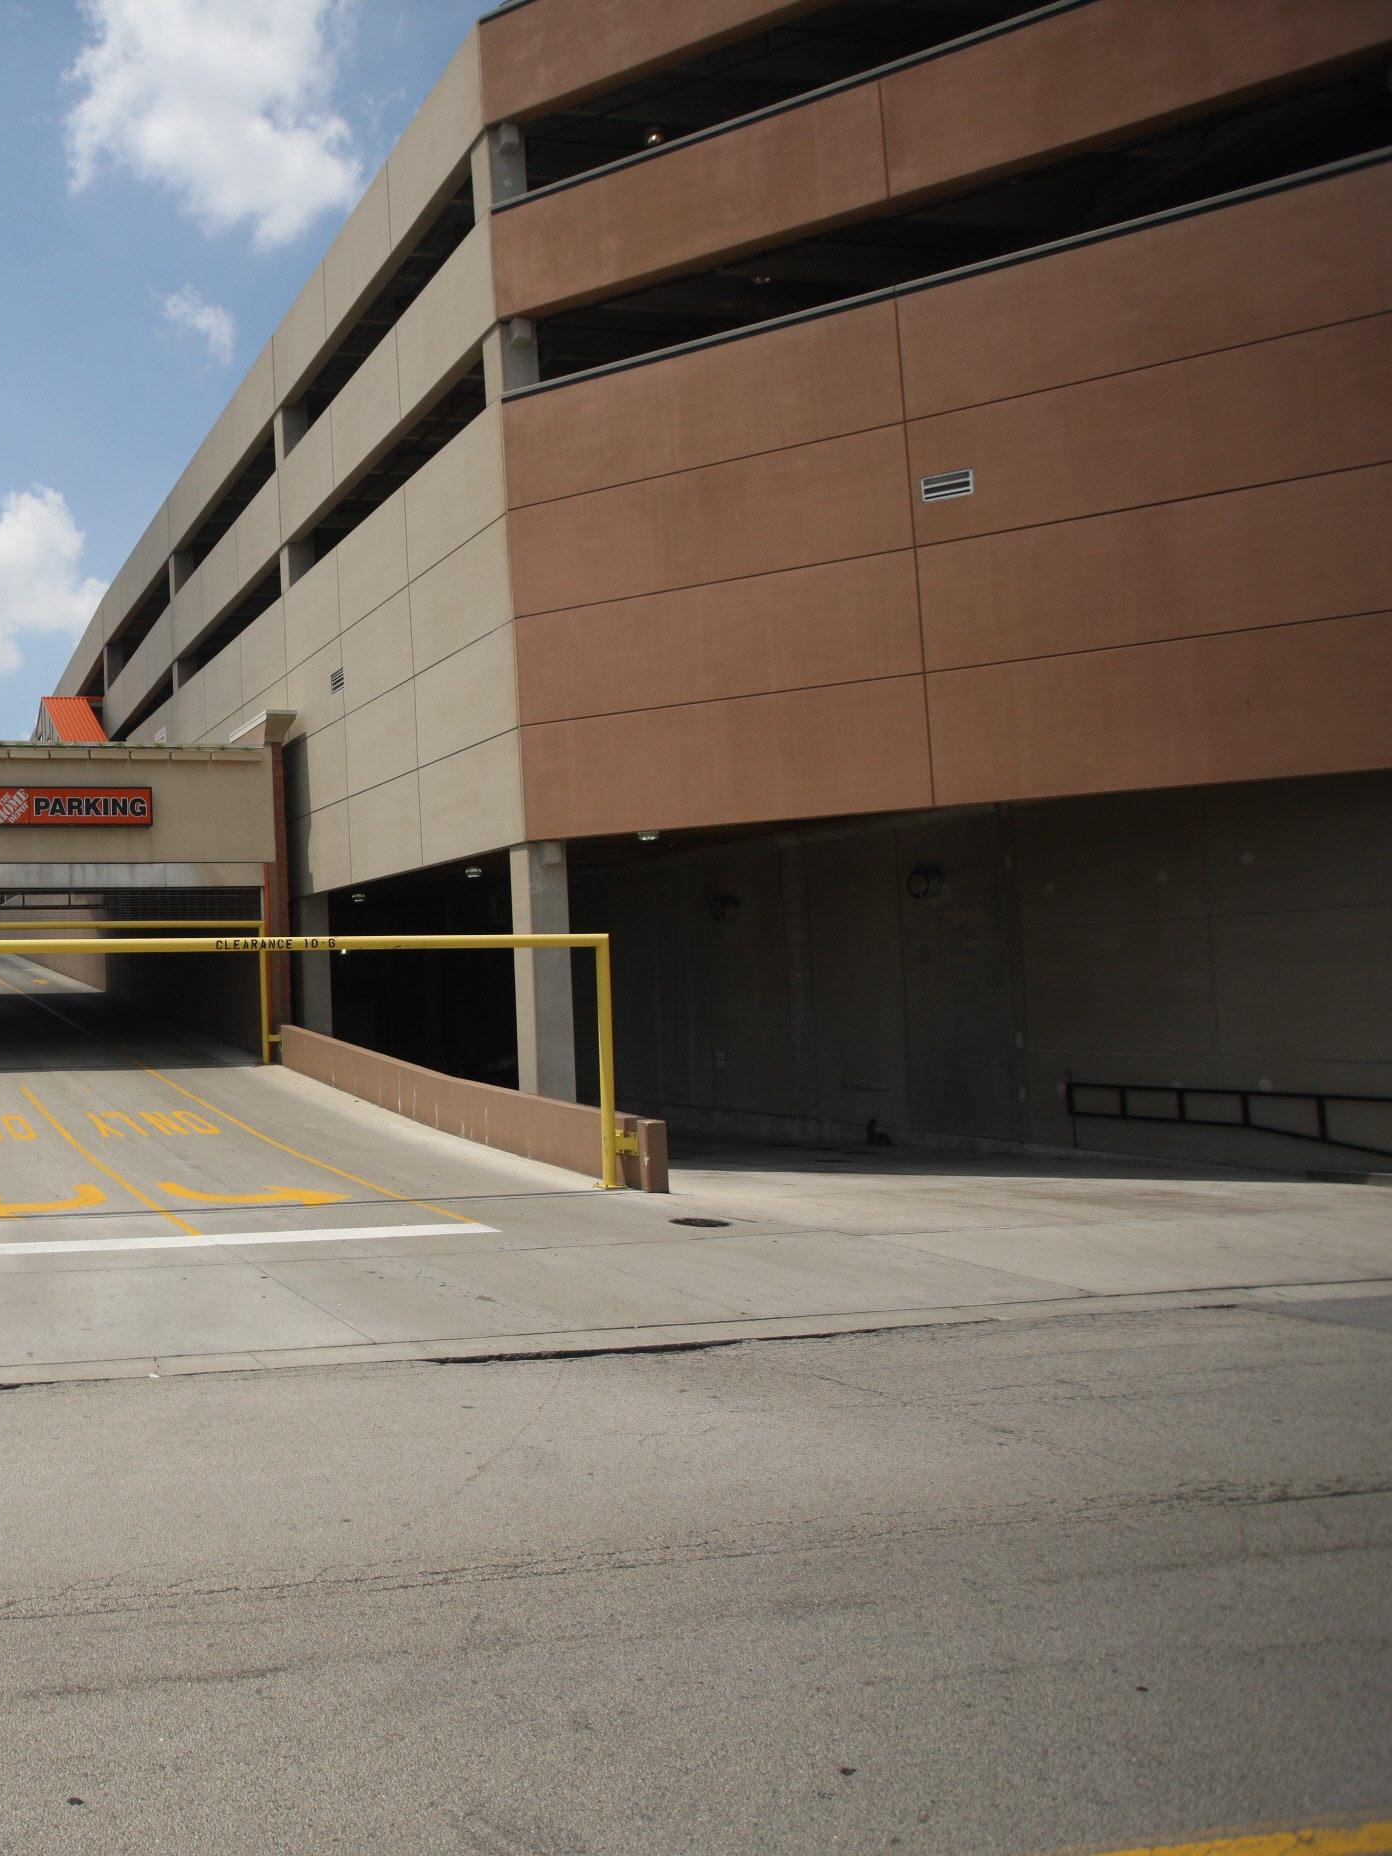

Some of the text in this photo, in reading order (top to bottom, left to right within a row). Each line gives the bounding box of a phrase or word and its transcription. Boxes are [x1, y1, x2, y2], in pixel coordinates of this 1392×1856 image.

[8, 801, 29, 824] DEPOT
[33, 796, 148, 817] PARKING
[215, 939, 293, 950] CLEARANCE
[84, 1110, 221, 1138] ONLY
